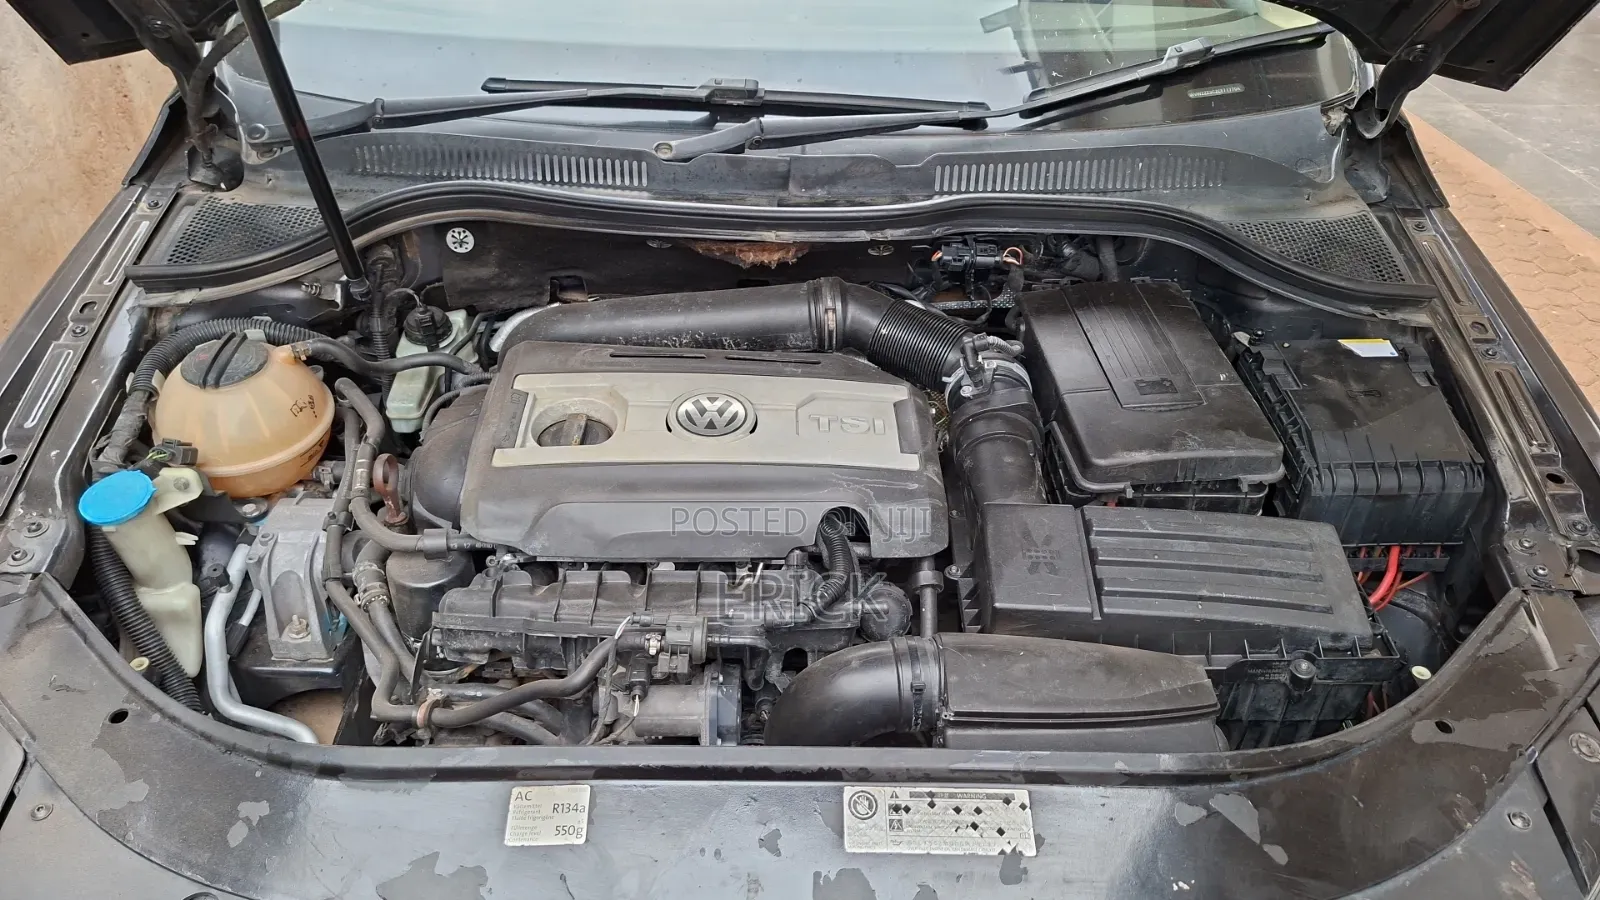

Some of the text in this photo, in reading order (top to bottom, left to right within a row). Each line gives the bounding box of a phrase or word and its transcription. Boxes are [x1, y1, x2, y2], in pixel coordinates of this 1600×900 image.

[809, 414, 885, 435] TSI
[514, 791, 533, 802] AC
[552, 803, 586, 814] R134a
[554, 825, 583, 839] 550g
